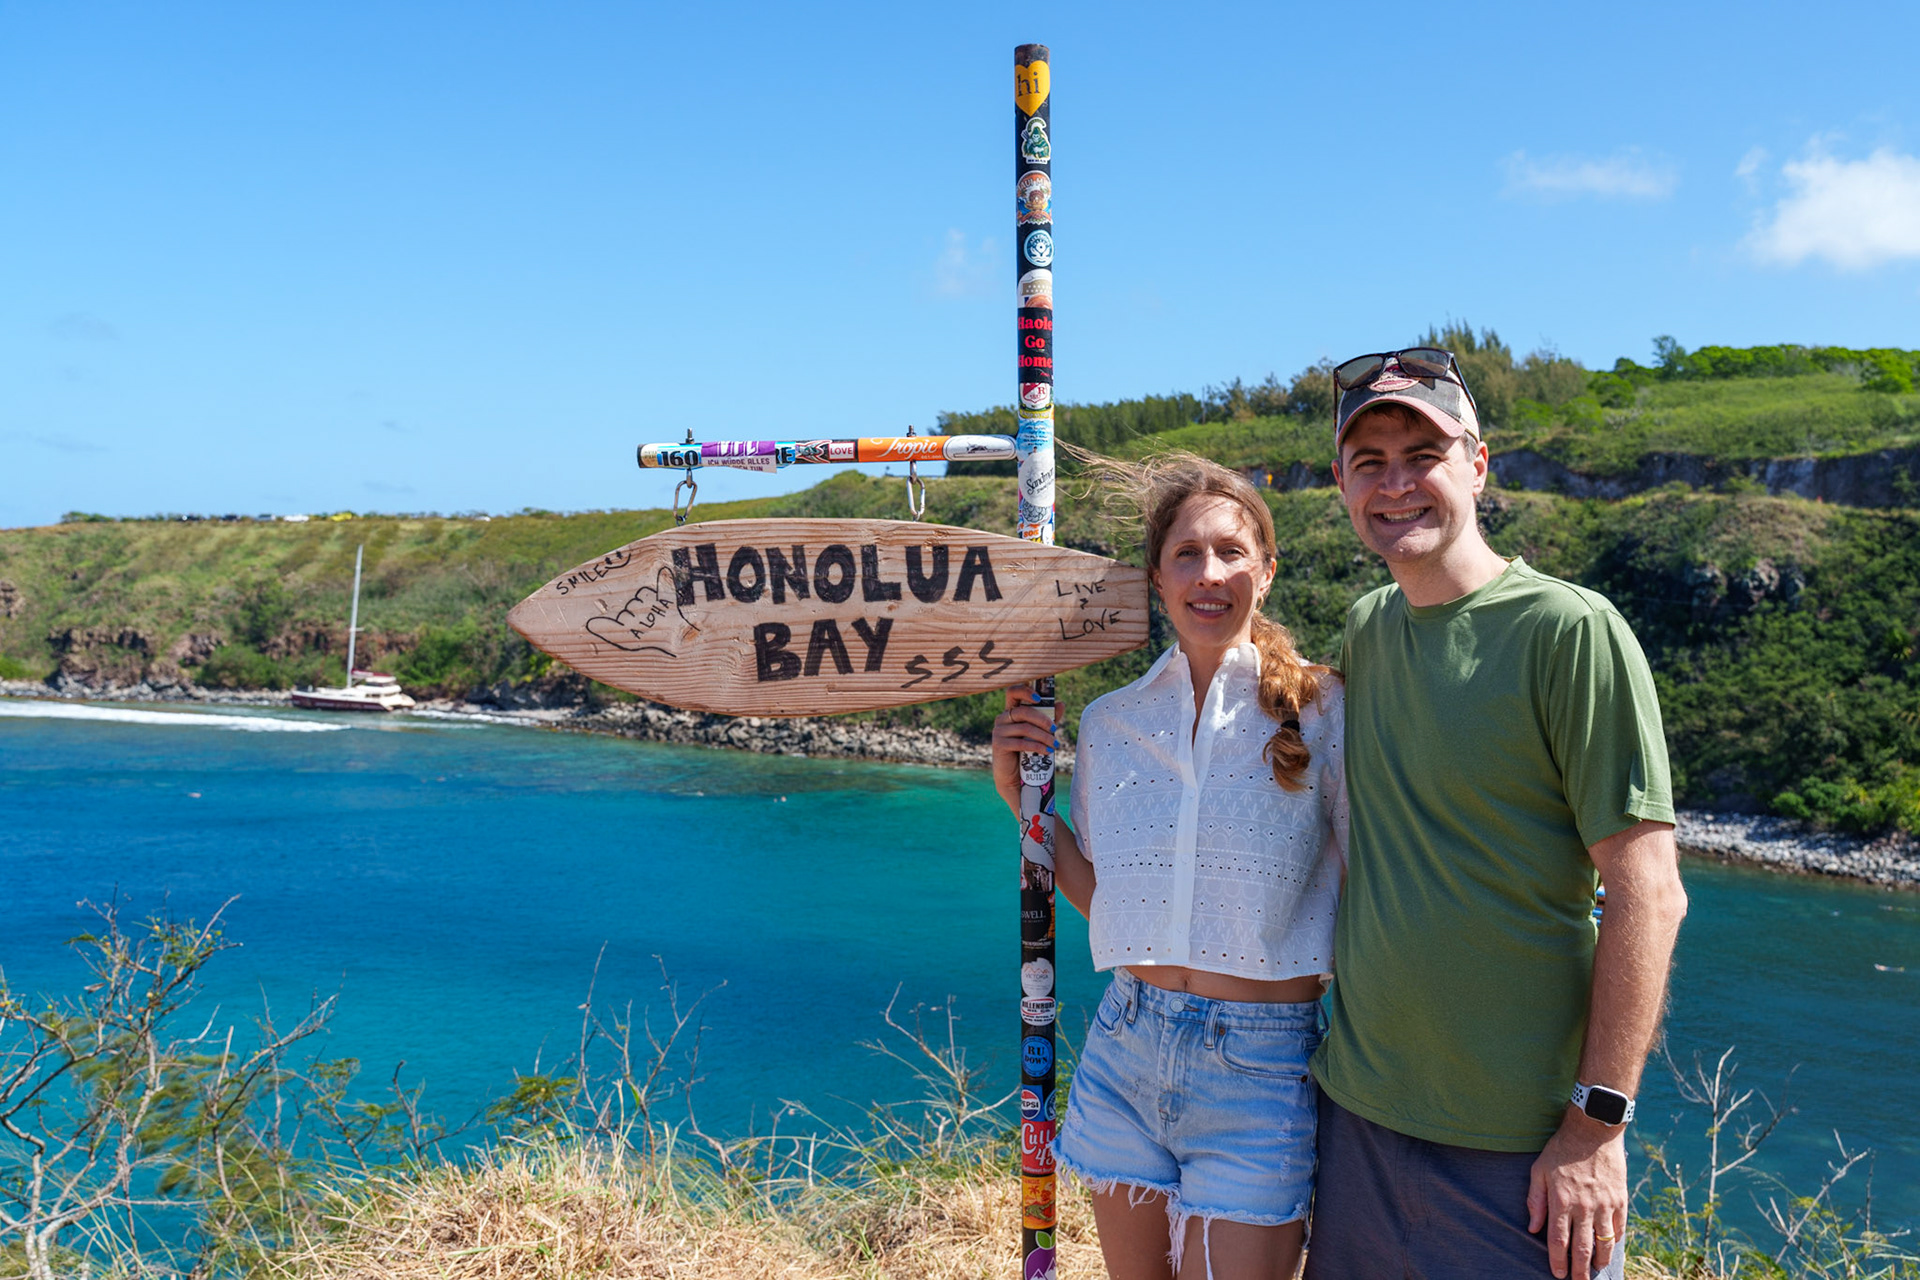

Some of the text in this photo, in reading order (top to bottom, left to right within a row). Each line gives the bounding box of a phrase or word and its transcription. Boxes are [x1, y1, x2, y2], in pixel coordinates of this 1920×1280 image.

[1017, 71, 1040, 97] hi
[1024, 334, 1046, 348] Go
[830, 446, 853, 456] LOVE
[870, 437, 938, 460] Tropic
[556, 564, 608, 595] SMILE
[671, 543, 1003, 607] HONOLUA
[1055, 579, 1106, 597] LIVE
[630, 599, 674, 639] ALOHA
[1059, 608, 1121, 640] LOVE
[754, 616, 895, 682] BAY
[1025, 773, 1048, 781] BUILT
[1024, 1055, 1048, 1065] DOWN
